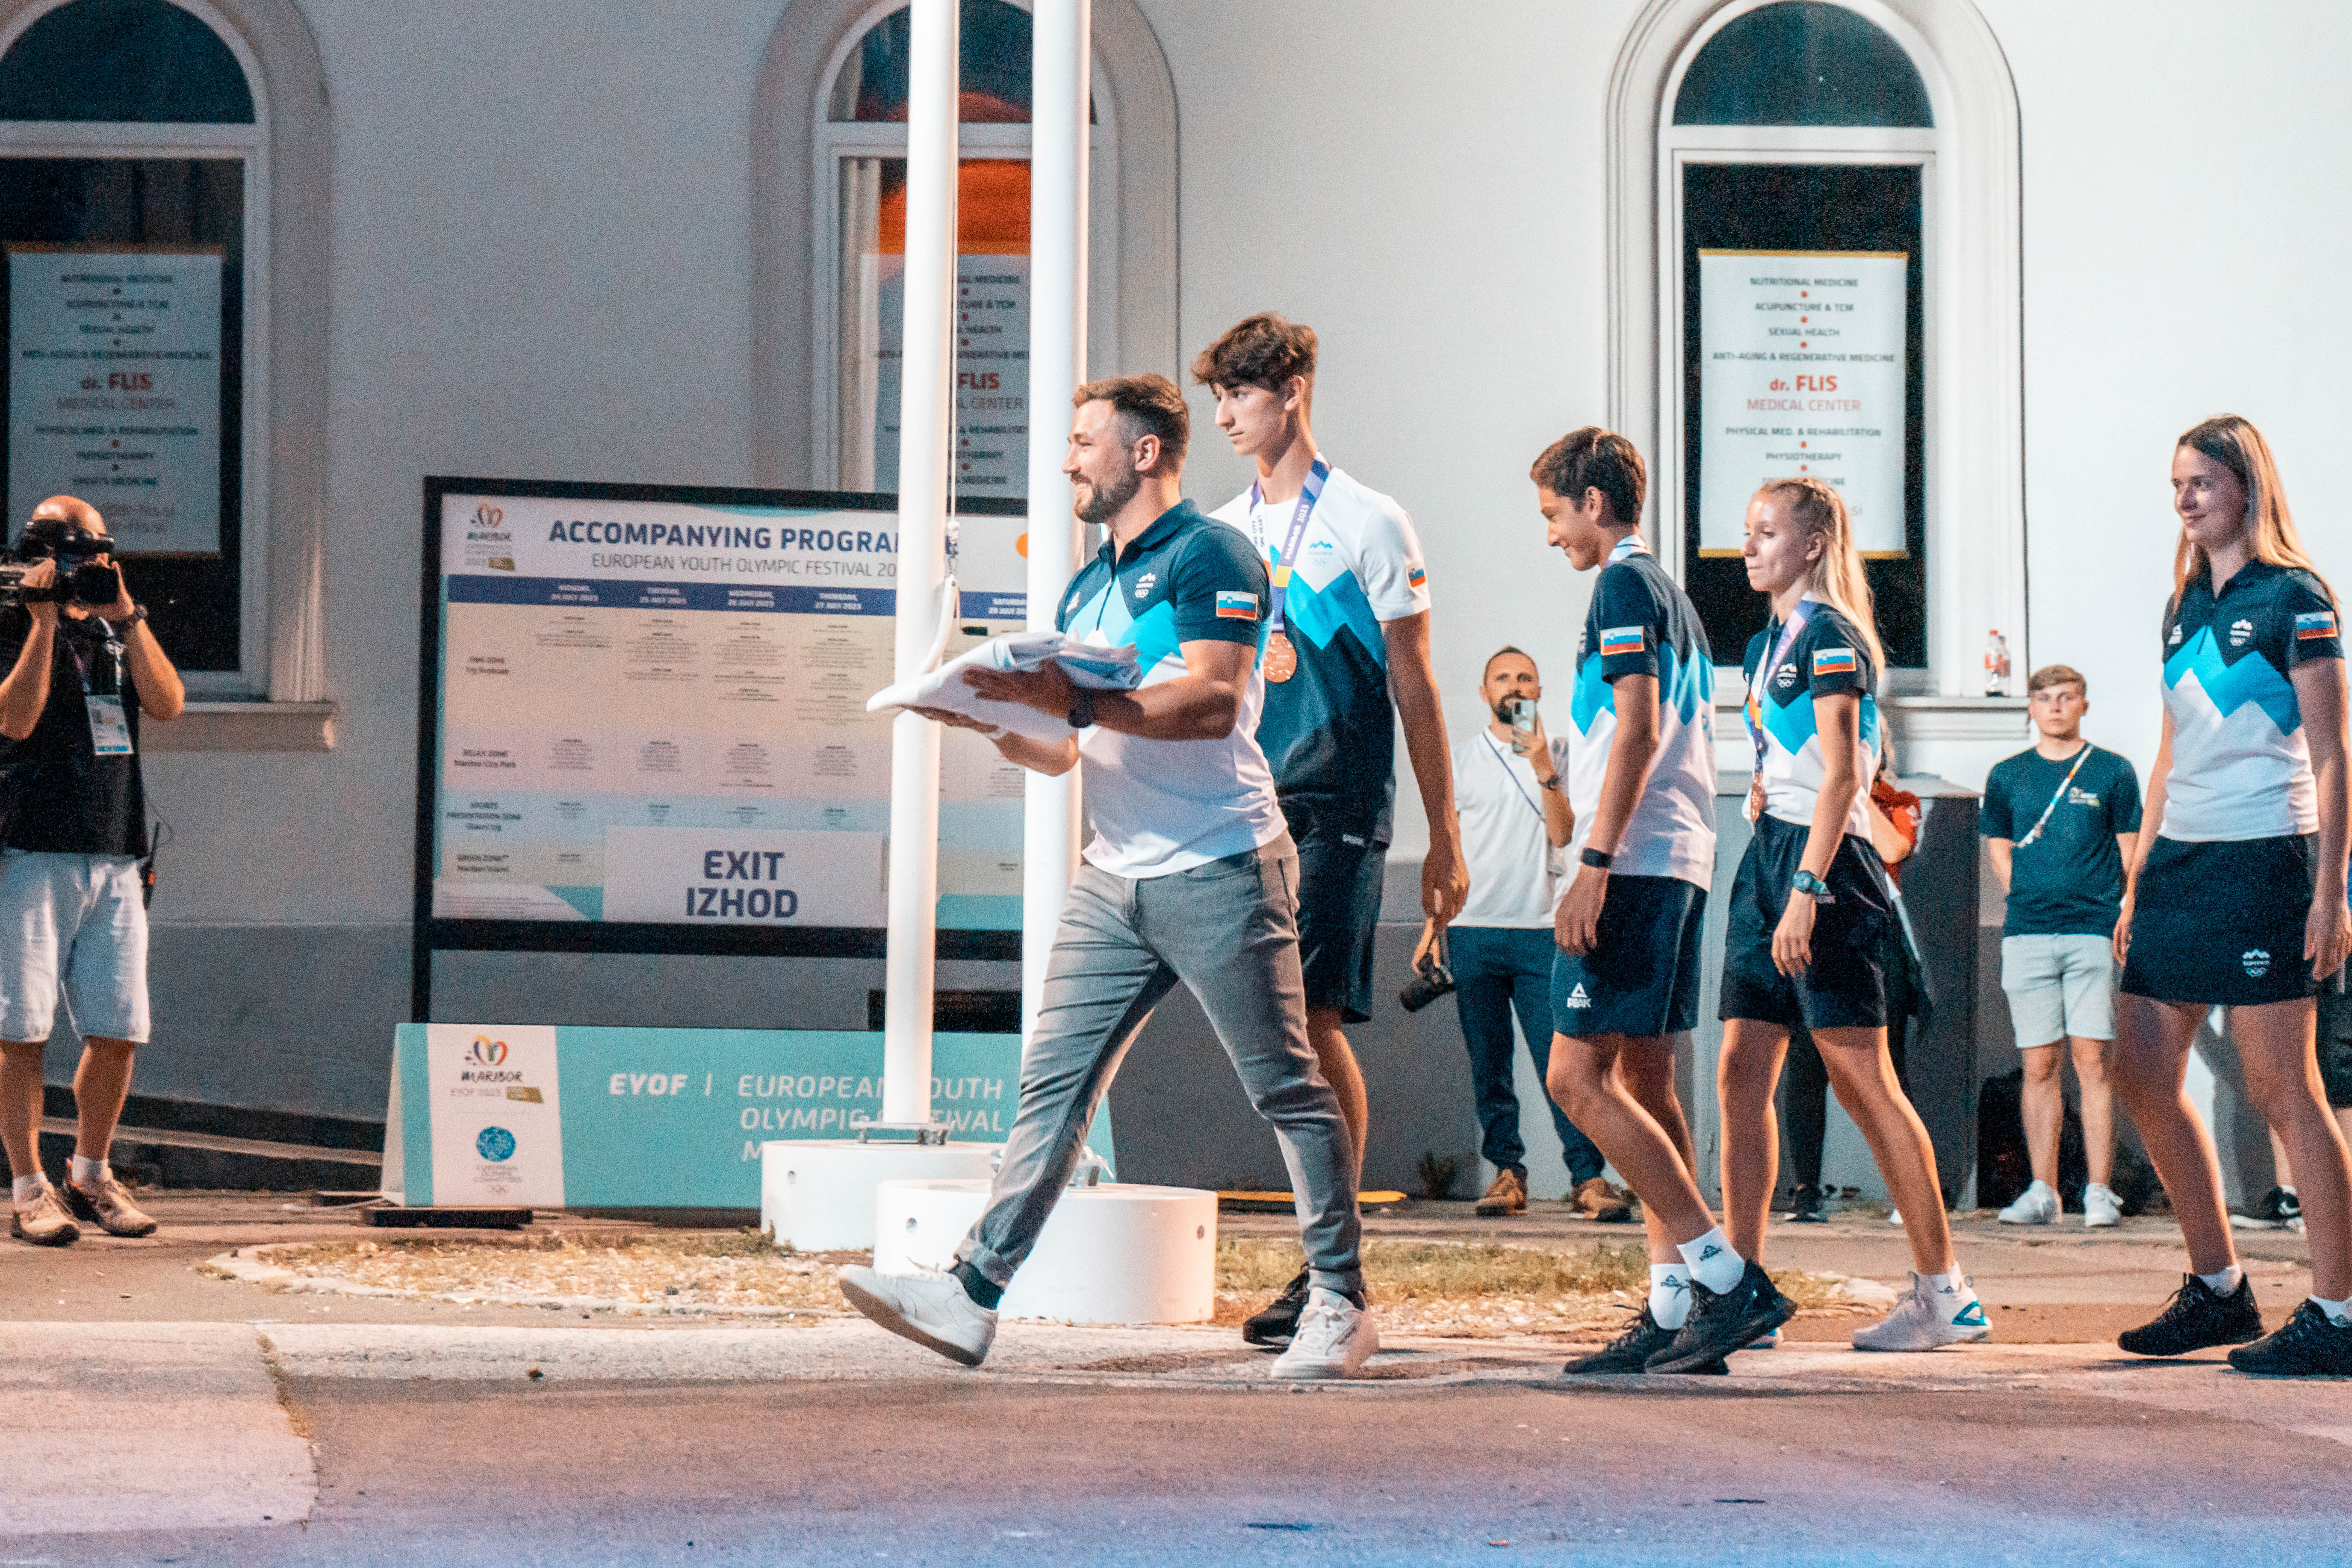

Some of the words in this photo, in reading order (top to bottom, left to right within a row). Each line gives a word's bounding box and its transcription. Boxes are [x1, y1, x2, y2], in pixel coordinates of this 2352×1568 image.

[1750, 277, 1811, 286] NUTRITIONAL
[1815, 278, 1858, 287] MEDICINE
[1755, 302, 1821, 311] ACUPUNCTURE
[1824, 303, 1832, 311] &
[1835, 303, 1853, 312] TCM
[1768, 328, 1801, 336] SEXUAL
[1805, 328, 1840, 337] HEALTH
[1713, 352, 1767, 361] ANTI-AGING
[1770, 352, 1776, 361] &
[1779, 353, 1846, 362] REGENERATIVE
[1850, 354, 1894, 363] MEDICINE
[109, 372, 151, 391] FLIS
[958, 373, 1000, 390] FLIS
[1769, 377, 1790, 392] dr.
[1796, 375, 1838, 392] FLIS
[971, 398, 1023, 410] CENTER
[1747, 399, 1804, 410] MEDICAL
[1809, 399, 1861, 411] CENTER
[1726, 427, 1768, 436] PHYSICAL
[1772, 428, 1794, 436] MED.
[1797, 428, 1804, 436] &
[1807, 428, 1881, 437] REHABILITATION
[1766, 452, 1842, 461] PHYSIOTHERAPY
[549, 520, 771, 550] ACCOMPANYING
[1284, 525, 1302, 560] MARIBOR
[1296, 504, 1310, 523] 2023
[592, 553, 674, 570] EUROPEAN
[682, 556, 731, 572] YOUTH
[735, 558, 800, 574] OLYMPIC
[805, 560, 871, 576] FESTIVAL
[703, 850, 785, 881] EXIT
[686, 887, 799, 918] IZHOD
[1567, 997, 1591, 1008] PEAK
[461, 1070, 524, 1084] MARIBOR
[610, 1073, 688, 1096] EYOF
[930, 1078, 1003, 1099] OUTH
